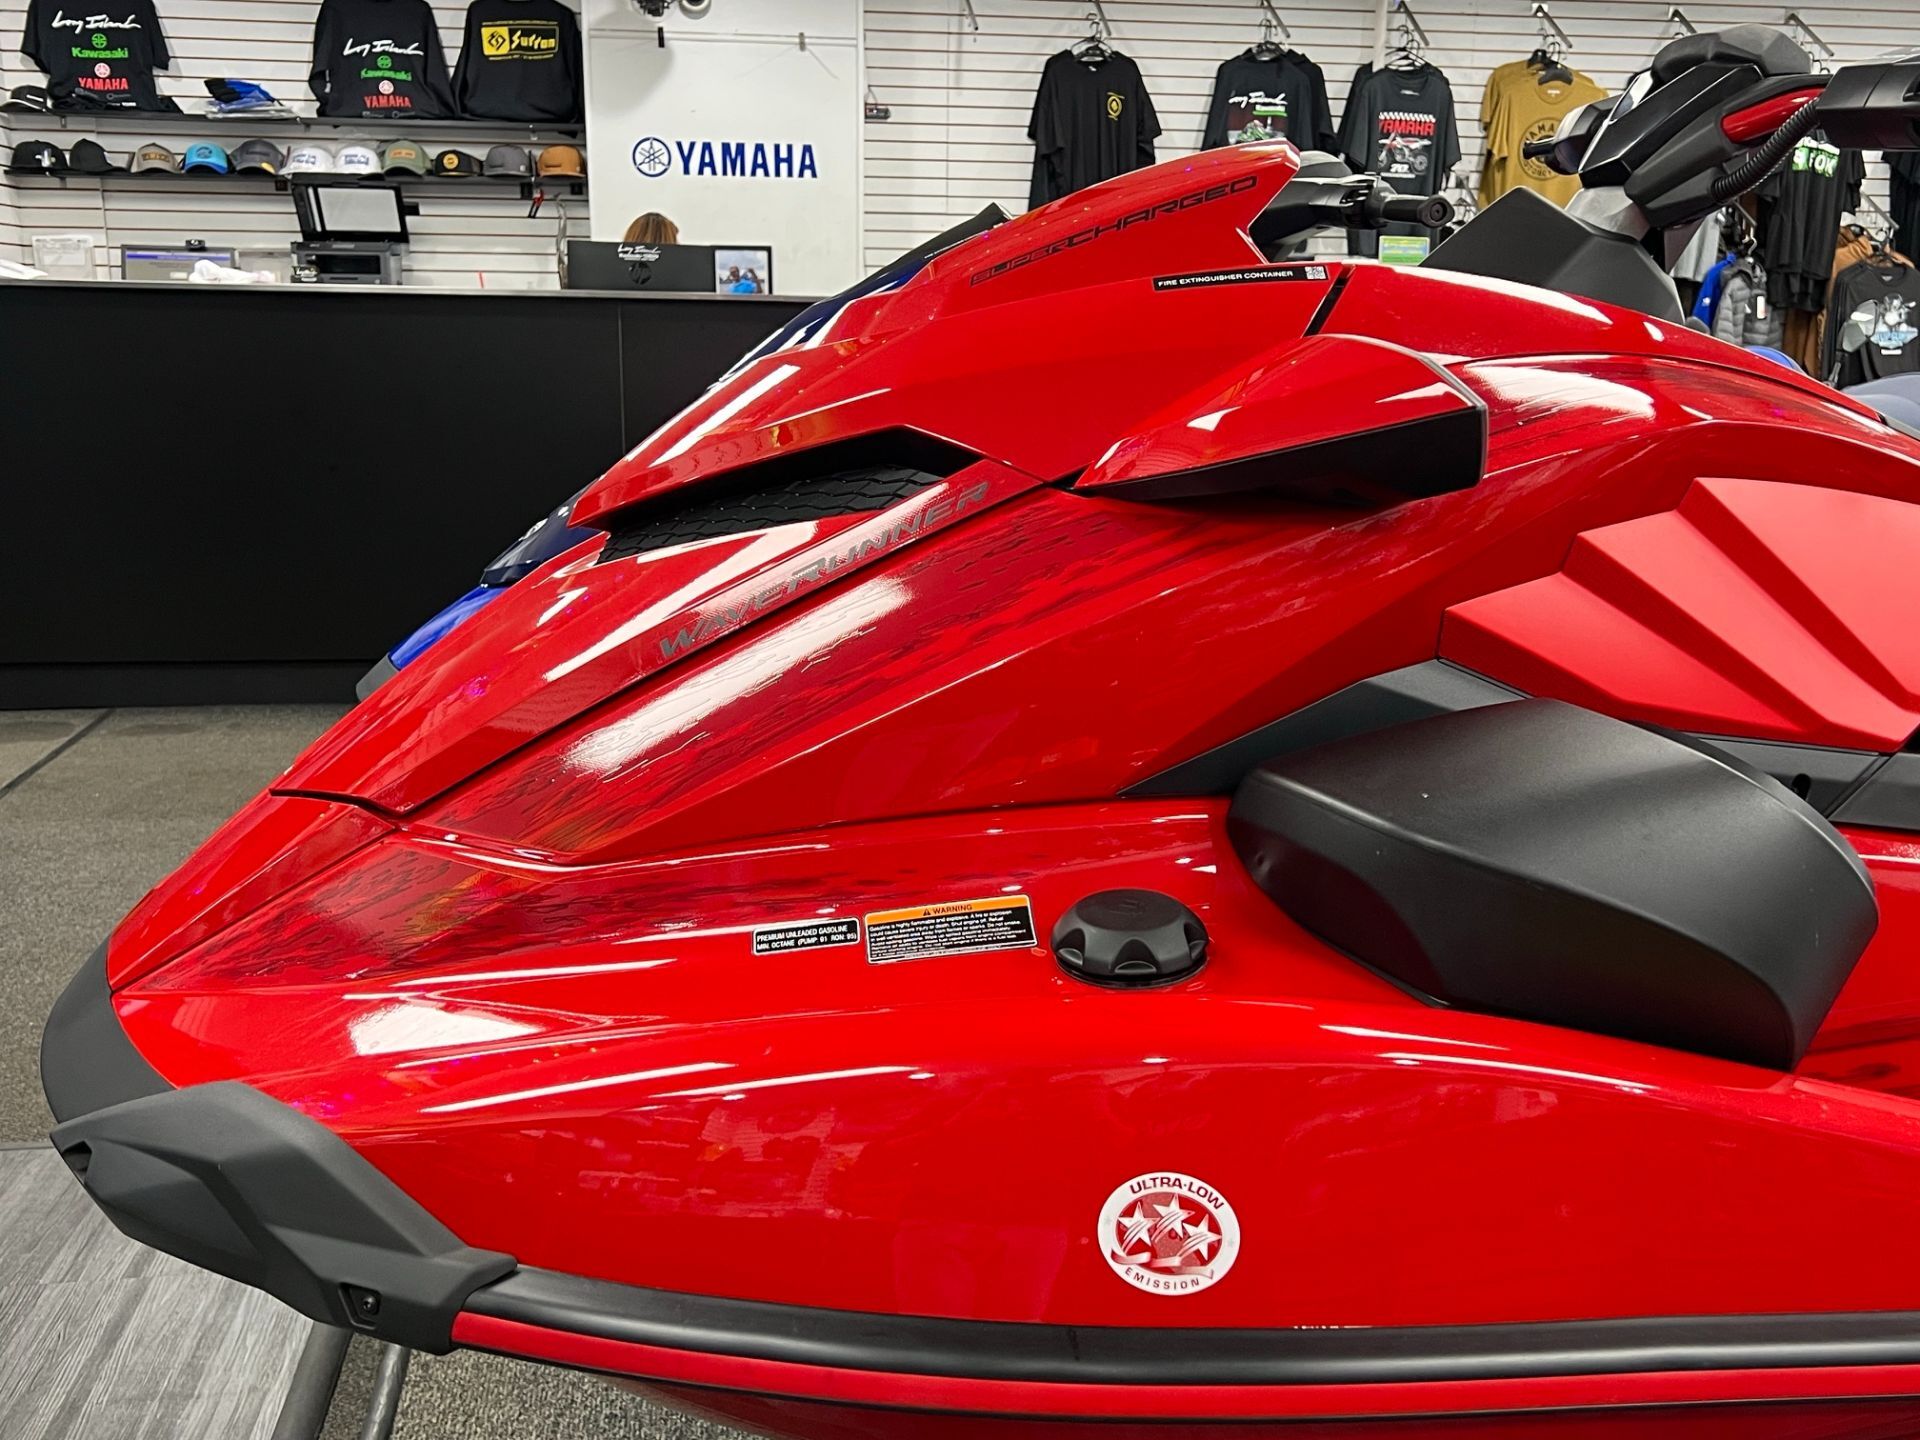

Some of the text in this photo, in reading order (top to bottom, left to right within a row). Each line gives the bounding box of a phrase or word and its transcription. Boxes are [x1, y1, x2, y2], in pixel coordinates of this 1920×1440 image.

[71, 47, 129, 58] Kawasaki
[79, 77, 129, 90] YAMAHA
[364, 95, 411, 108] YAMAHA
[675, 141, 818, 178] YAMAHA
[969, 176, 1259, 288] SUPERCHARGED
[1179, 273, 1243, 285] EXTINGUISHER
[1243, 270, 1293, 280] CONTAINER
[659, 480, 989, 658] WAVERUNNER
[933, 904, 973, 915] WARNING
[757, 925, 847, 942] PREMIUM UNLEADED GASOLINE
[771, 939, 794, 949] OCTANE
[1125, 1267, 1200, 1290] EMISSION
